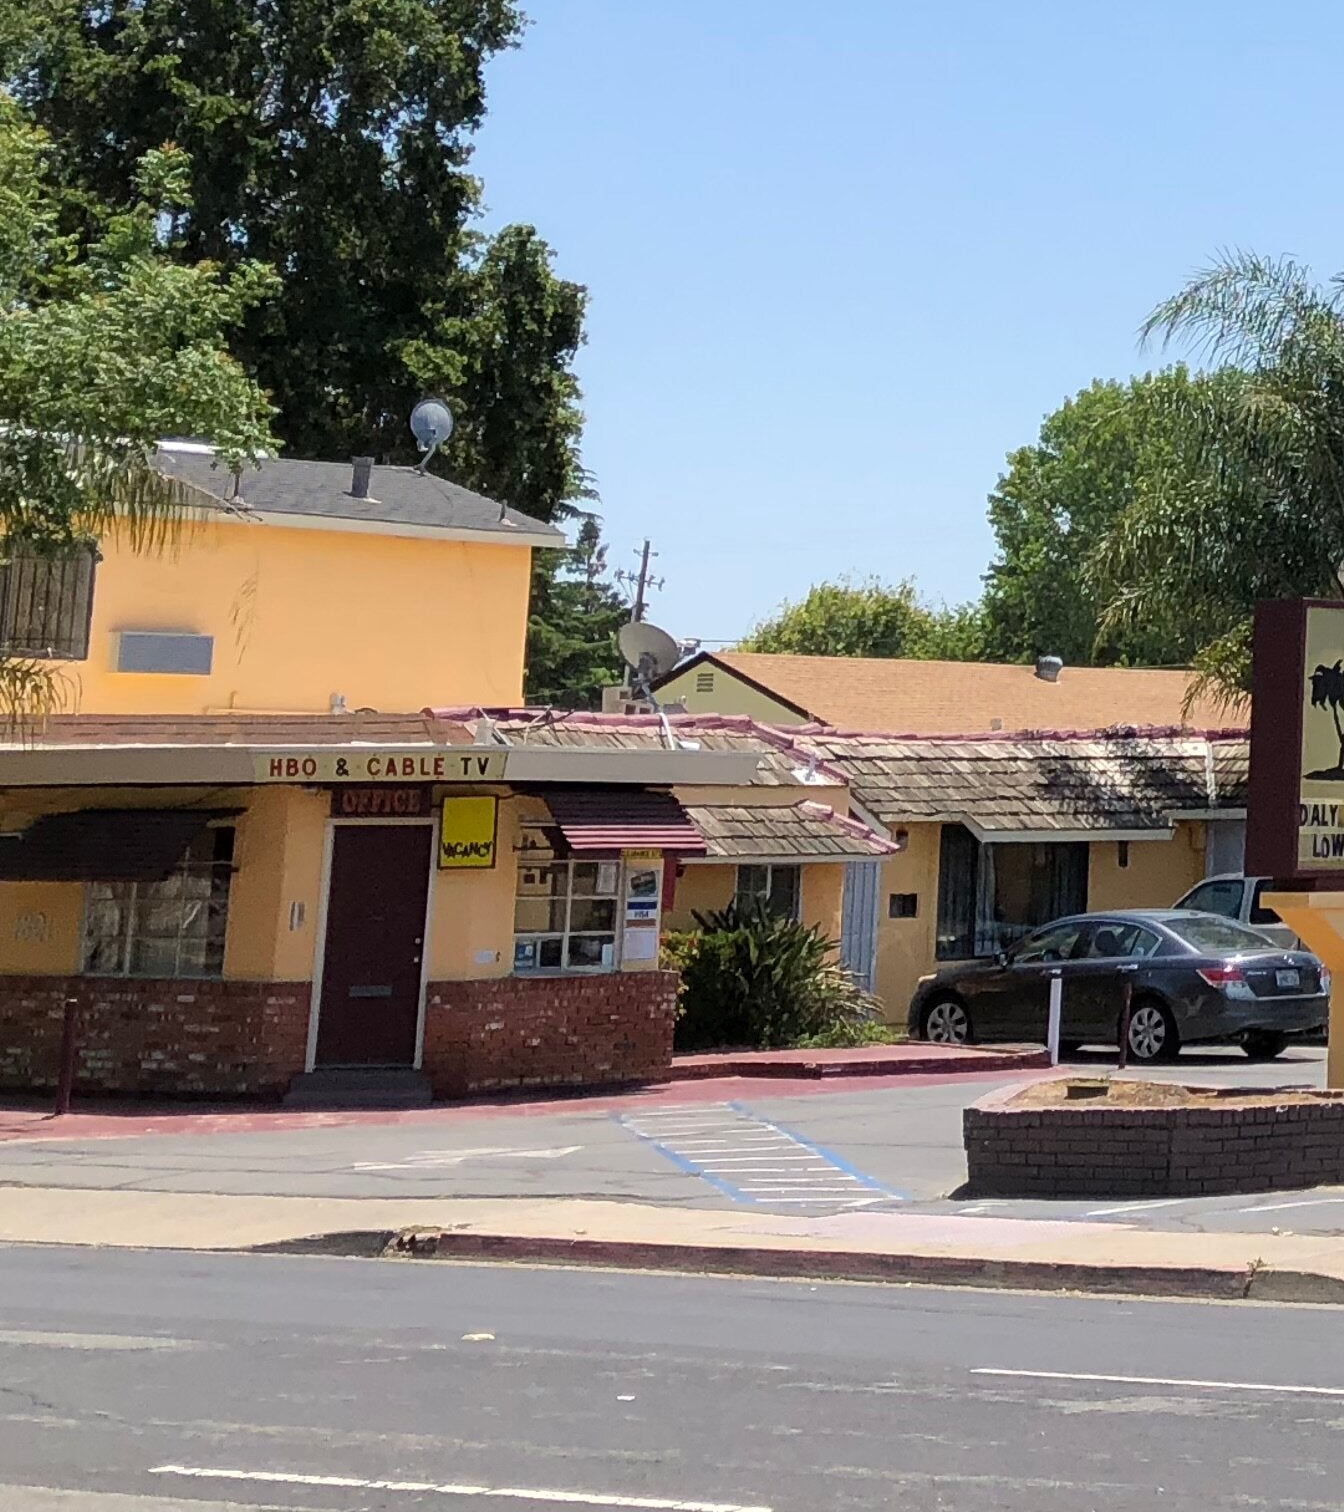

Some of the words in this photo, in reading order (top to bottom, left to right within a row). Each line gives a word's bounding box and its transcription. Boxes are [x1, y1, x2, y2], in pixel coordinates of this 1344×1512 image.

[269, 757, 317, 777] HBO
[335, 758, 349, 777] &
[366, 757, 445, 777] CABLE
[460, 757, 490, 776] TV
[342, 789, 420, 812] OFFICE
[443, 841, 493, 858] VACANCY
[1313, 833, 1344, 858] LOW
